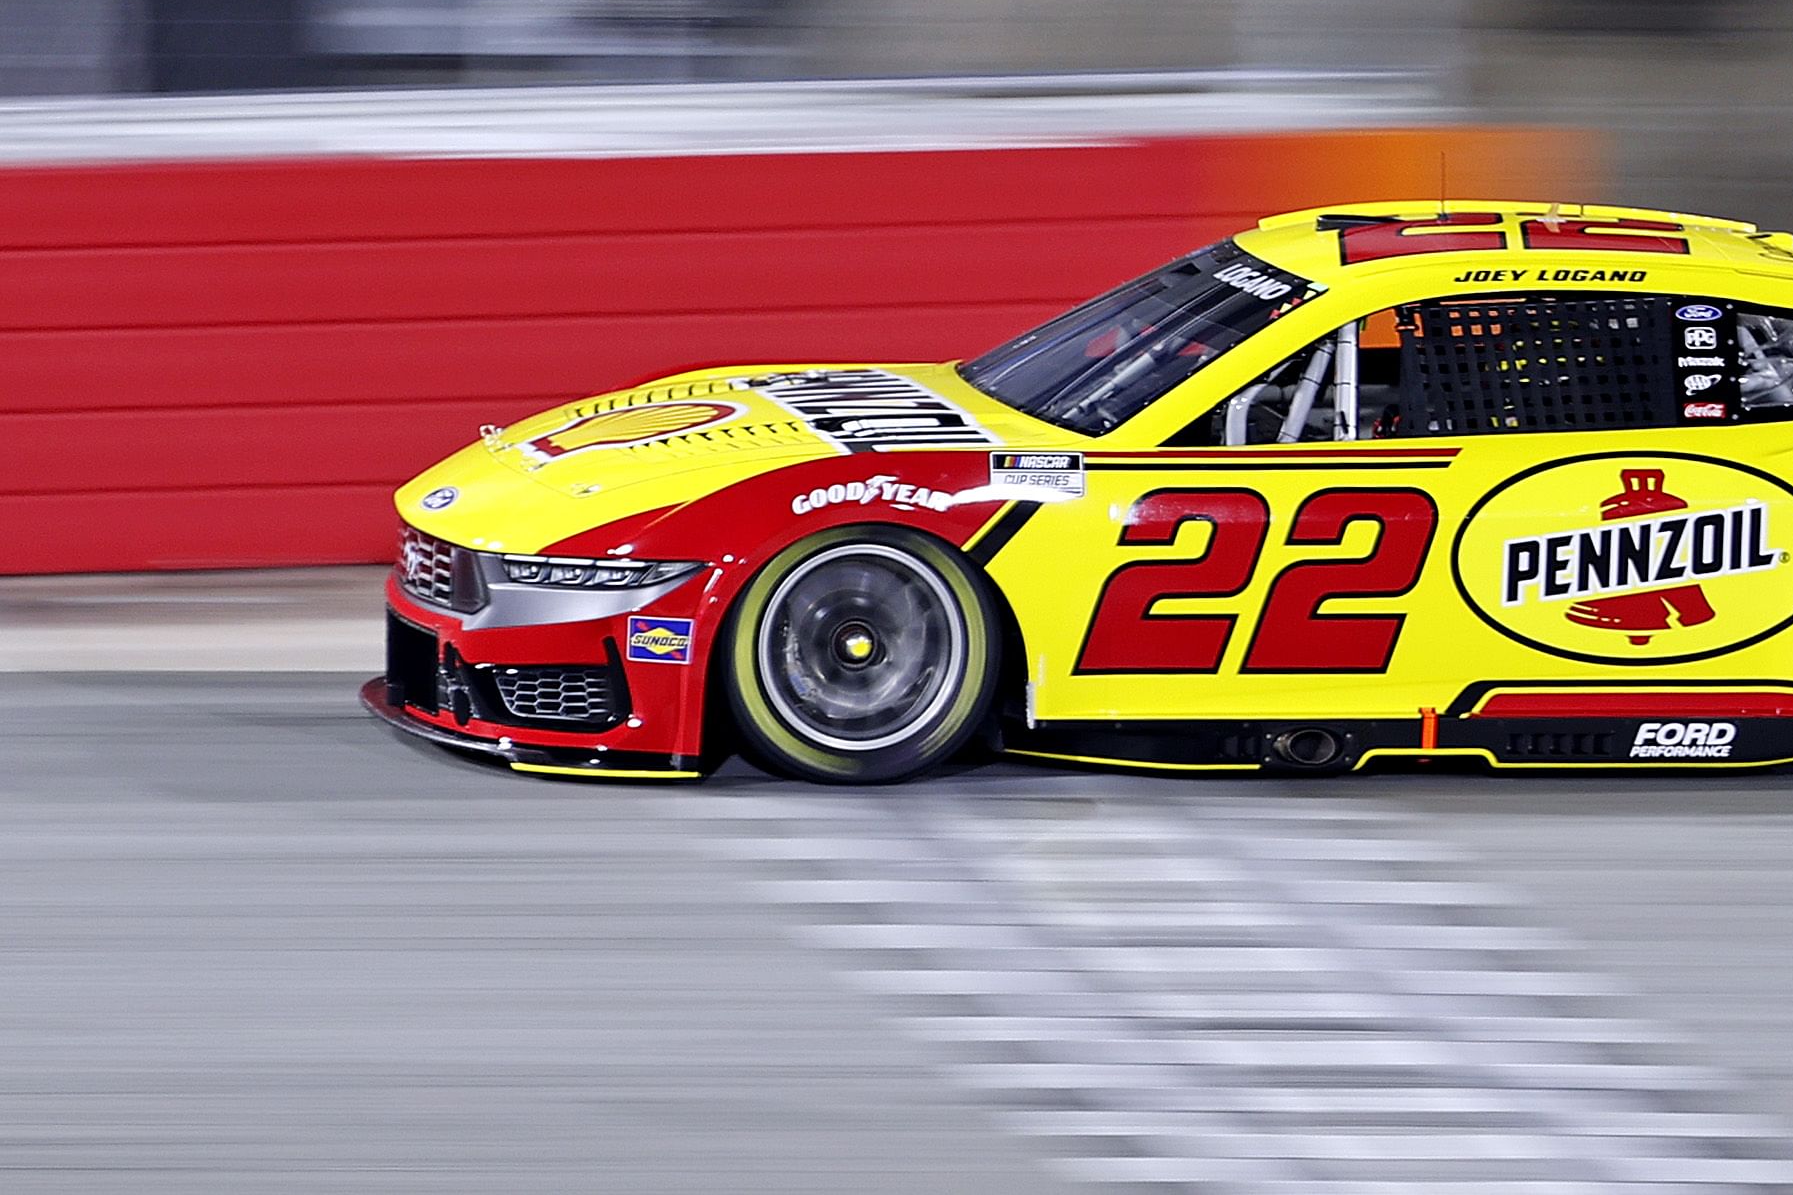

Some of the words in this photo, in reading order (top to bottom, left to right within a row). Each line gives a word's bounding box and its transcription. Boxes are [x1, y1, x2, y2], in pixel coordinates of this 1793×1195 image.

[1213, 263, 1292, 301] LOGANO
[1454, 269, 1529, 283] JOEY
[1536, 269, 1647, 283] LOGANO
[1018, 456, 1070, 469] NASCAR
[1004, 475, 1027, 485] CUP
[1030, 475, 1069, 485] SERIES
[1506, 504, 1775, 603] PENNZOIL
[1072, 487, 1439, 675] 22
[633, 635, 687, 647] SUNOCO
[1634, 722, 1736, 745] FORD
[1629, 745, 1732, 757] PERFORMANCE
